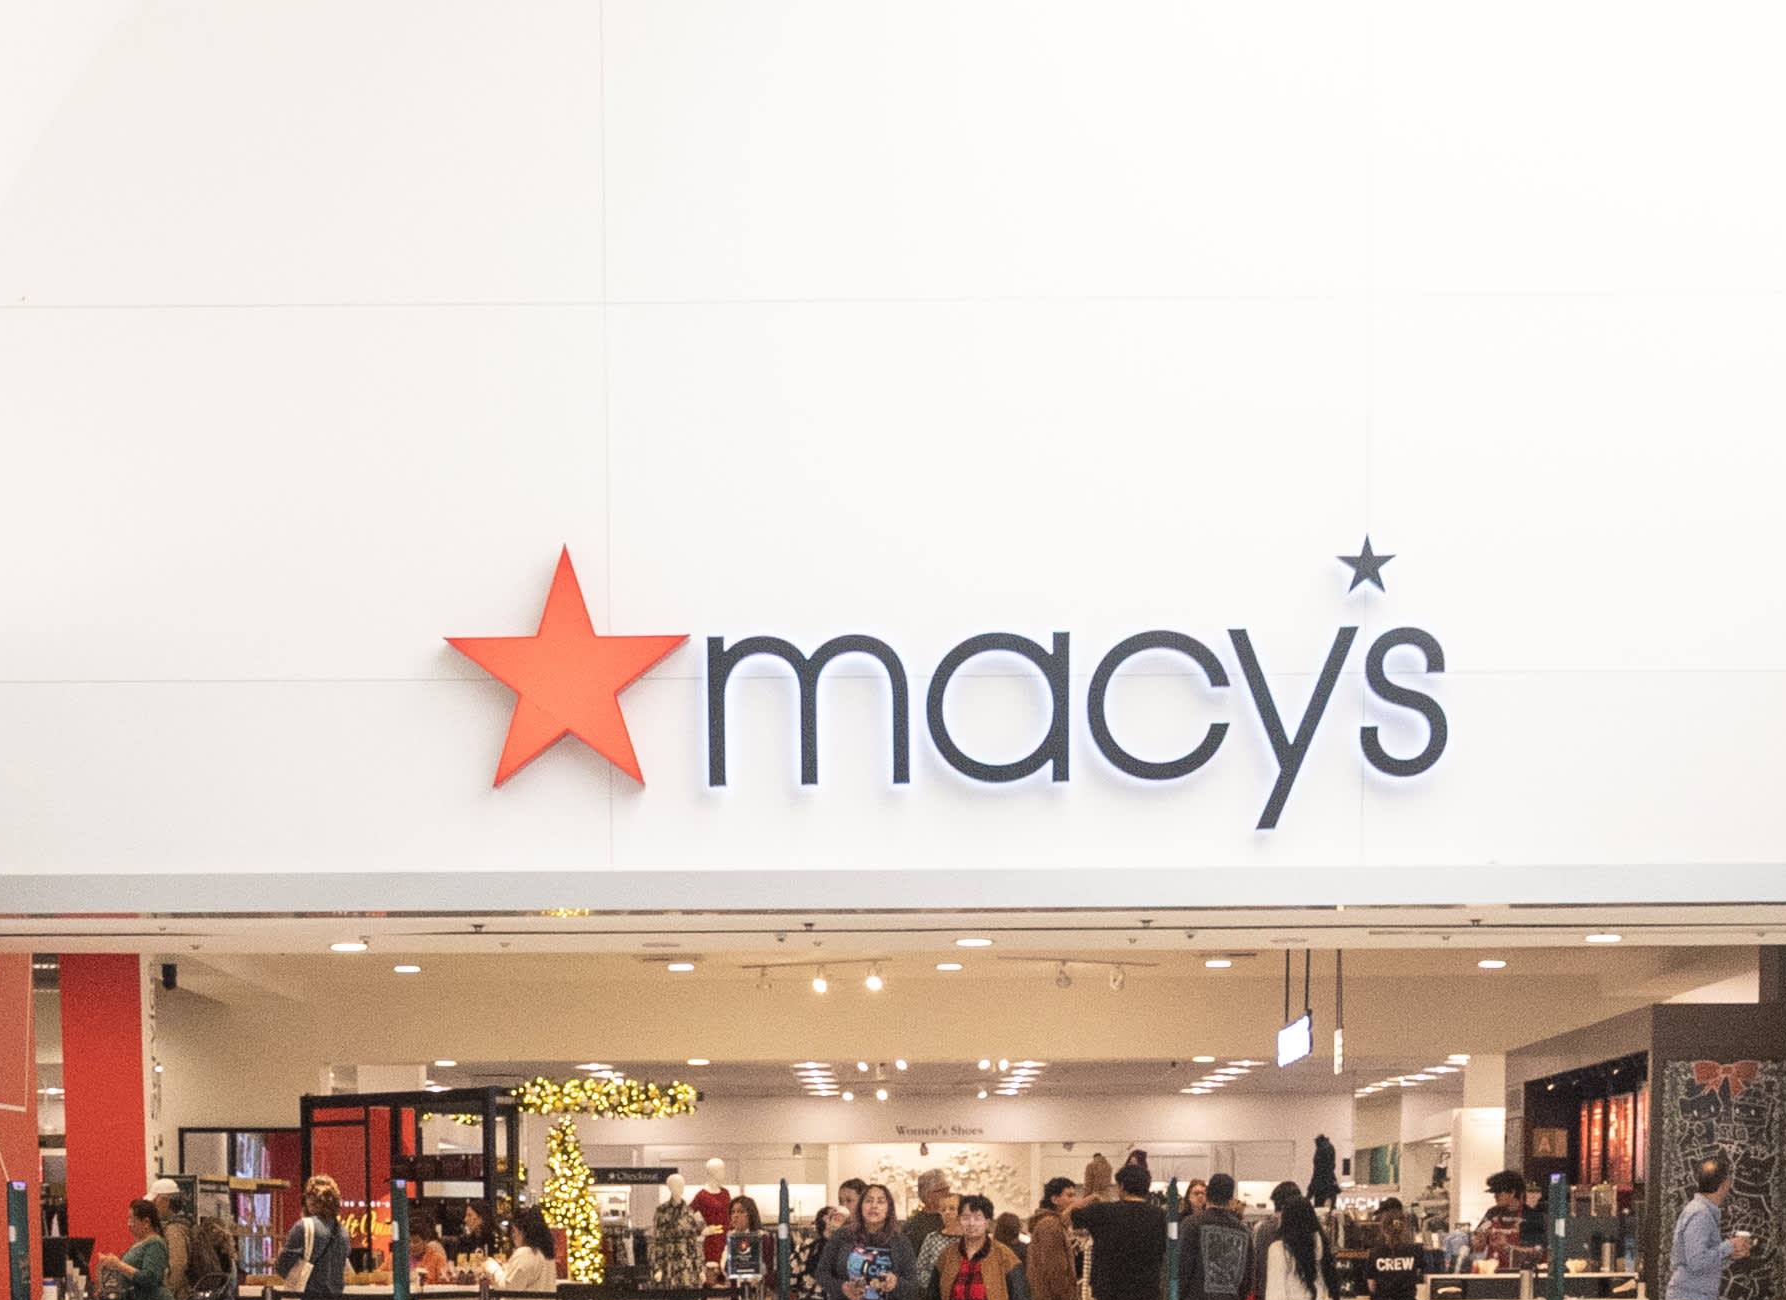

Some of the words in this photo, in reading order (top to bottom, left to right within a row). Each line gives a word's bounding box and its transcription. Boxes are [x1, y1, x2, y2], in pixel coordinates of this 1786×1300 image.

[895, 1125, 947, 1136] Women's
[951, 1125, 984, 1136] Shoes
[1375, 1256, 1415, 1272] CREW
